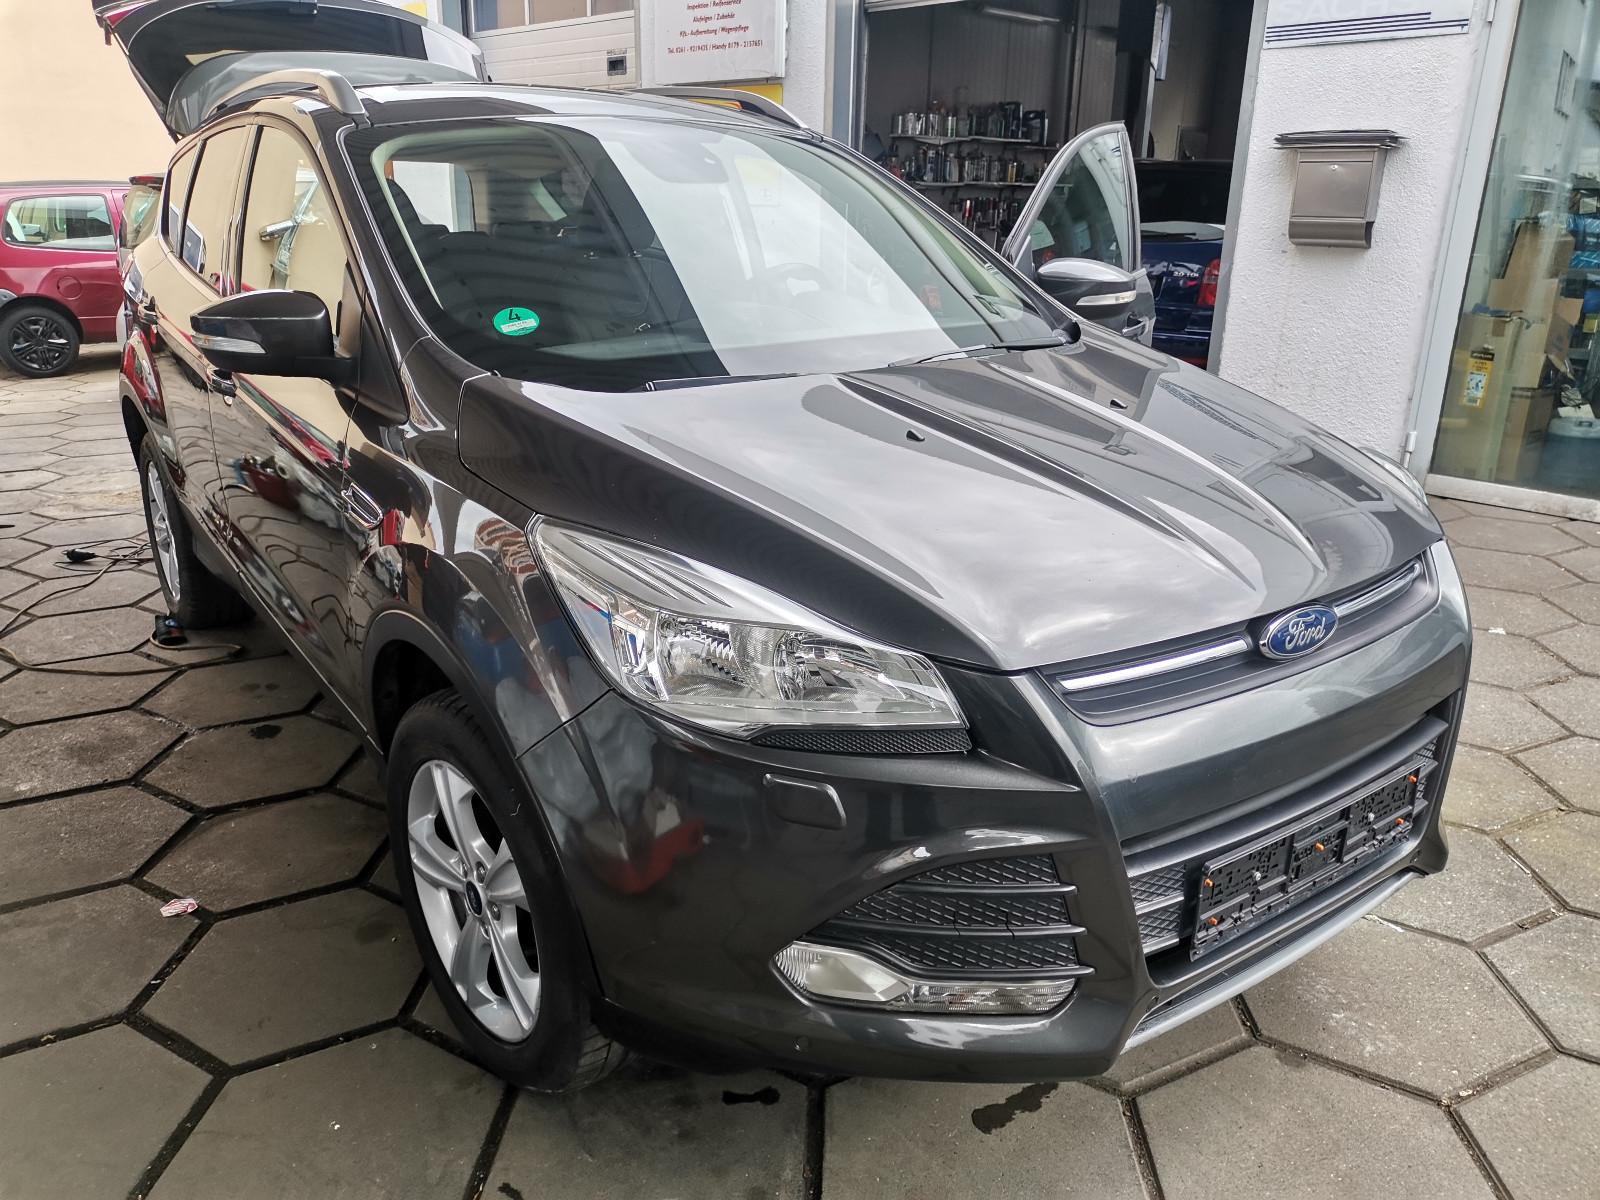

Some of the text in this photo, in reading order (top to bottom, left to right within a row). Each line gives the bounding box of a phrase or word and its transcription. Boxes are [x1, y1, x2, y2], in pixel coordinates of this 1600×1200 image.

[711, 43, 727, 52] Handy
[508, 308, 520, 321] 4
[1285, 614, 1326, 650] Ford
